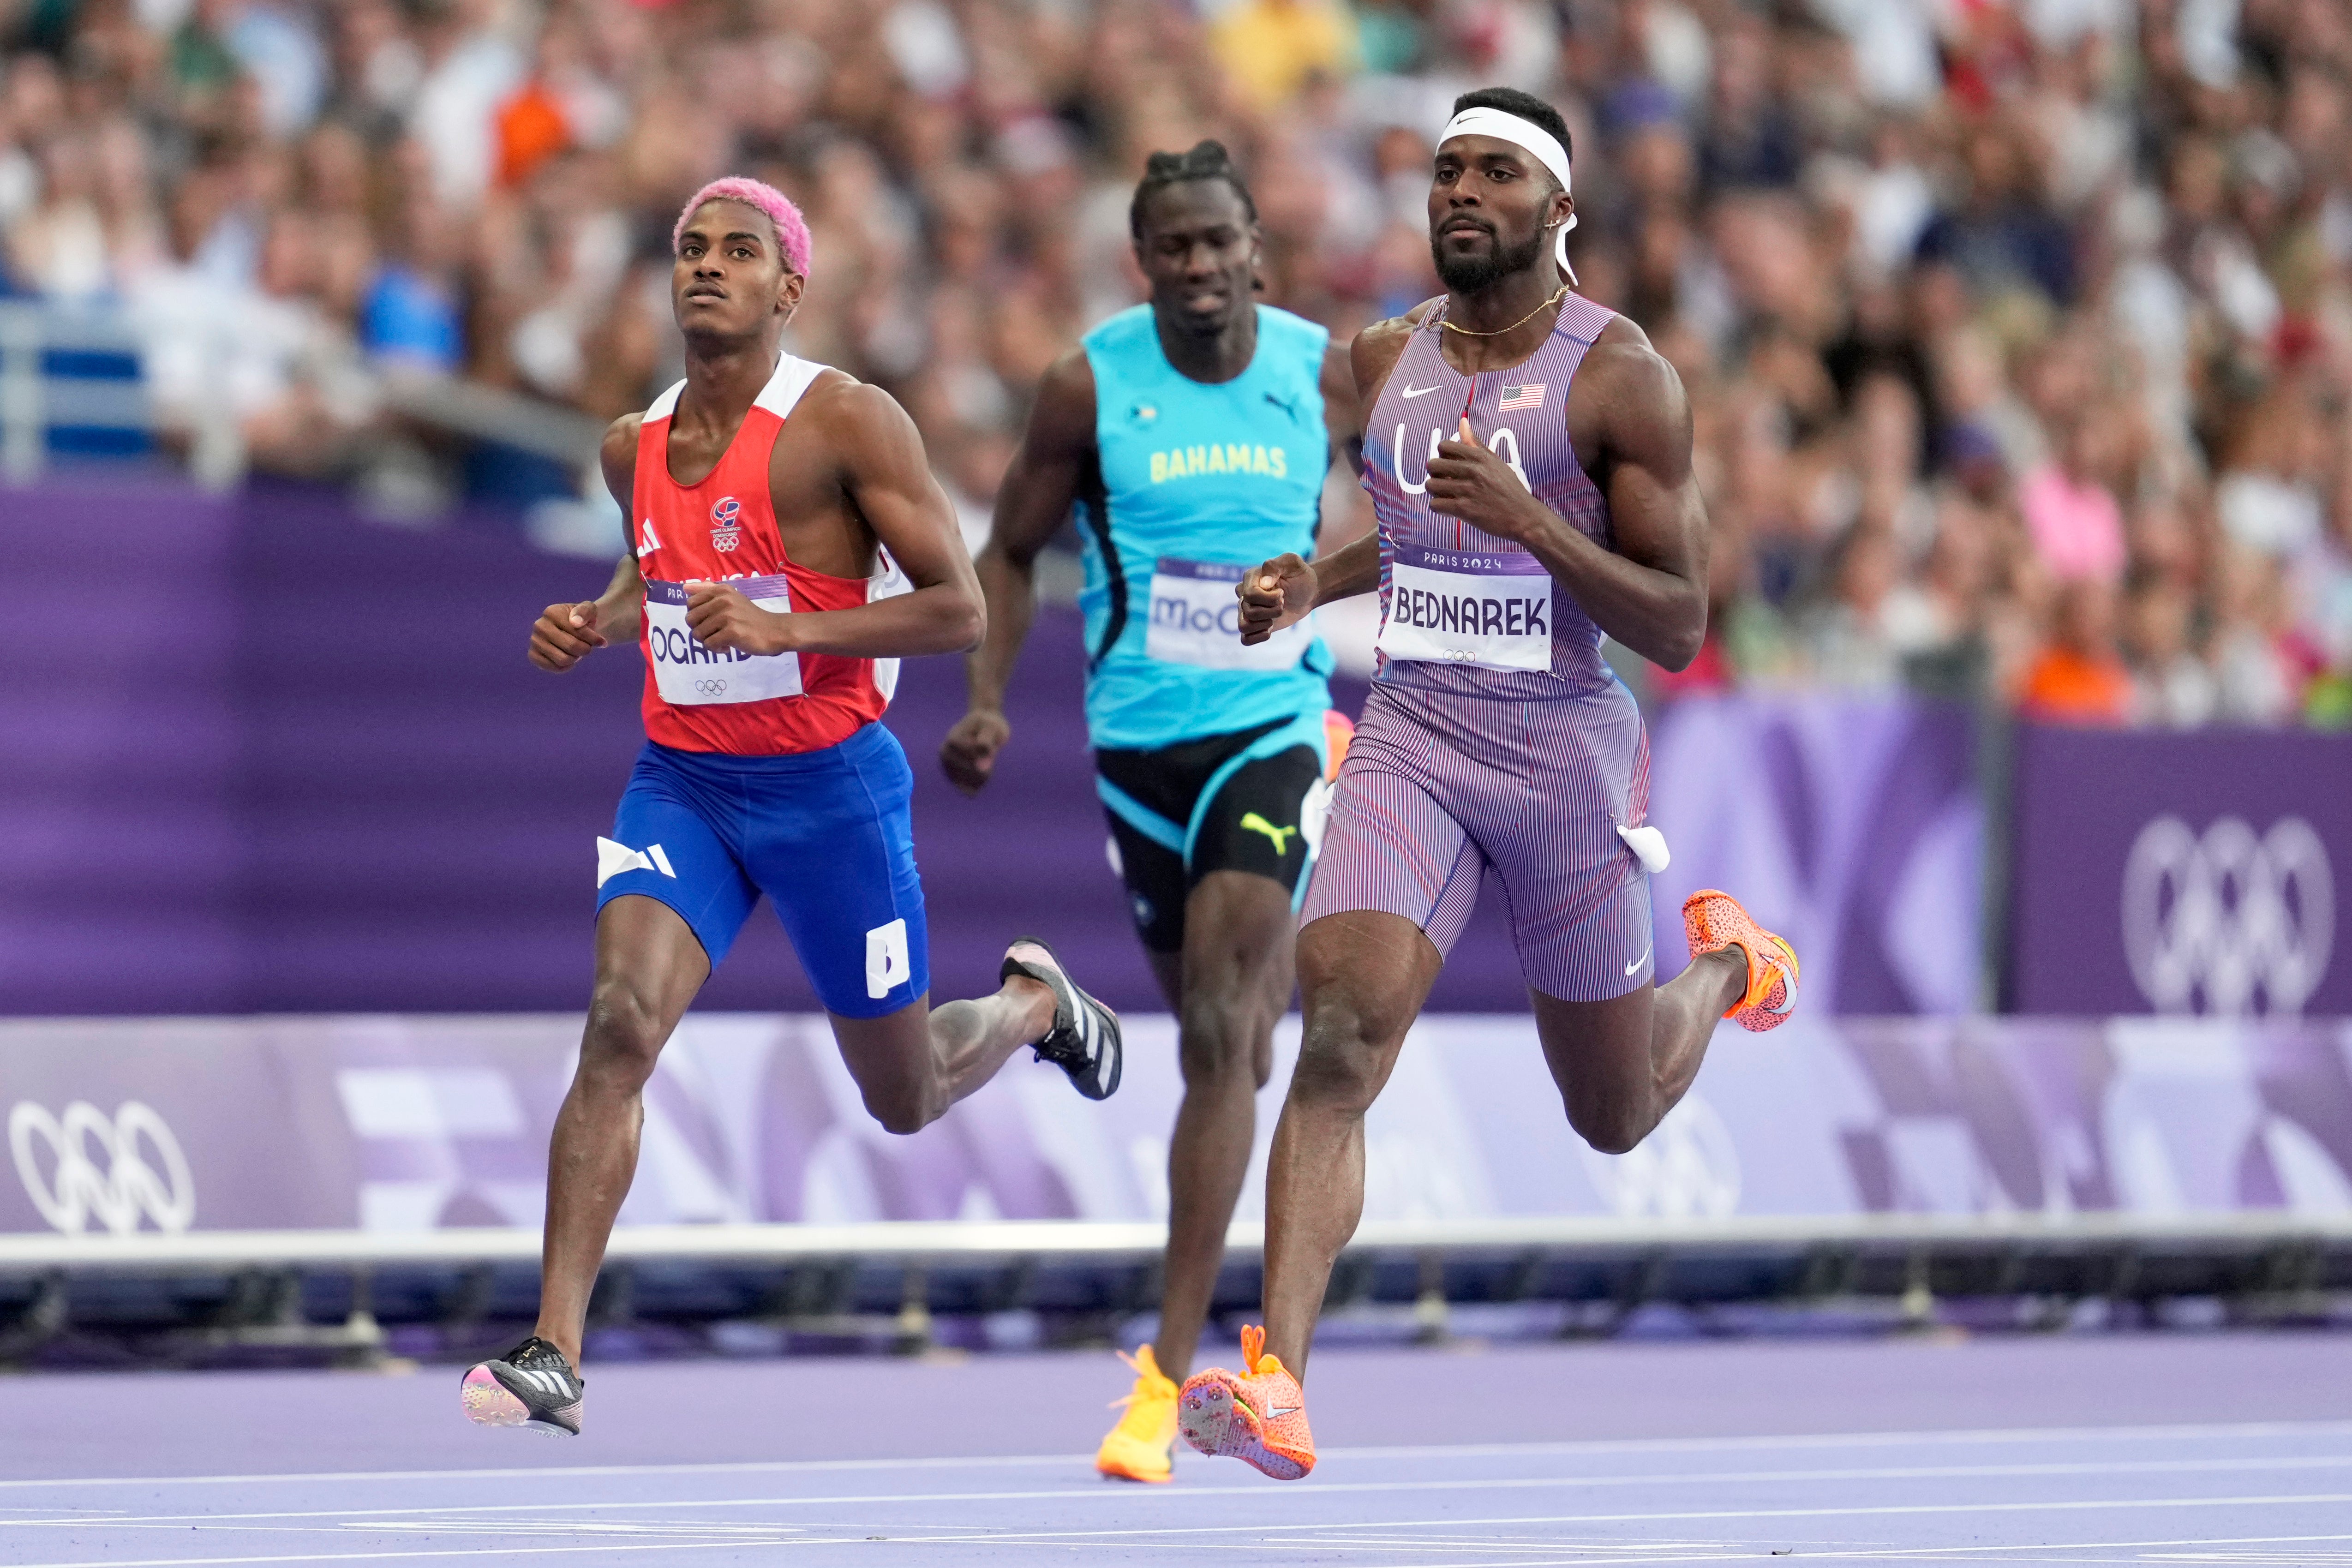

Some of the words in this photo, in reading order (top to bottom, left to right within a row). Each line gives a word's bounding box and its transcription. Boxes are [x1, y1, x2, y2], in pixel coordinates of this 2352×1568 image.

[1151, 444, 1287, 482] BAHAMAS
[1394, 423, 1532, 494] UA
[1462, 557, 1501, 569] 2024
[1394, 586, 1546, 635] BEDNAREK
